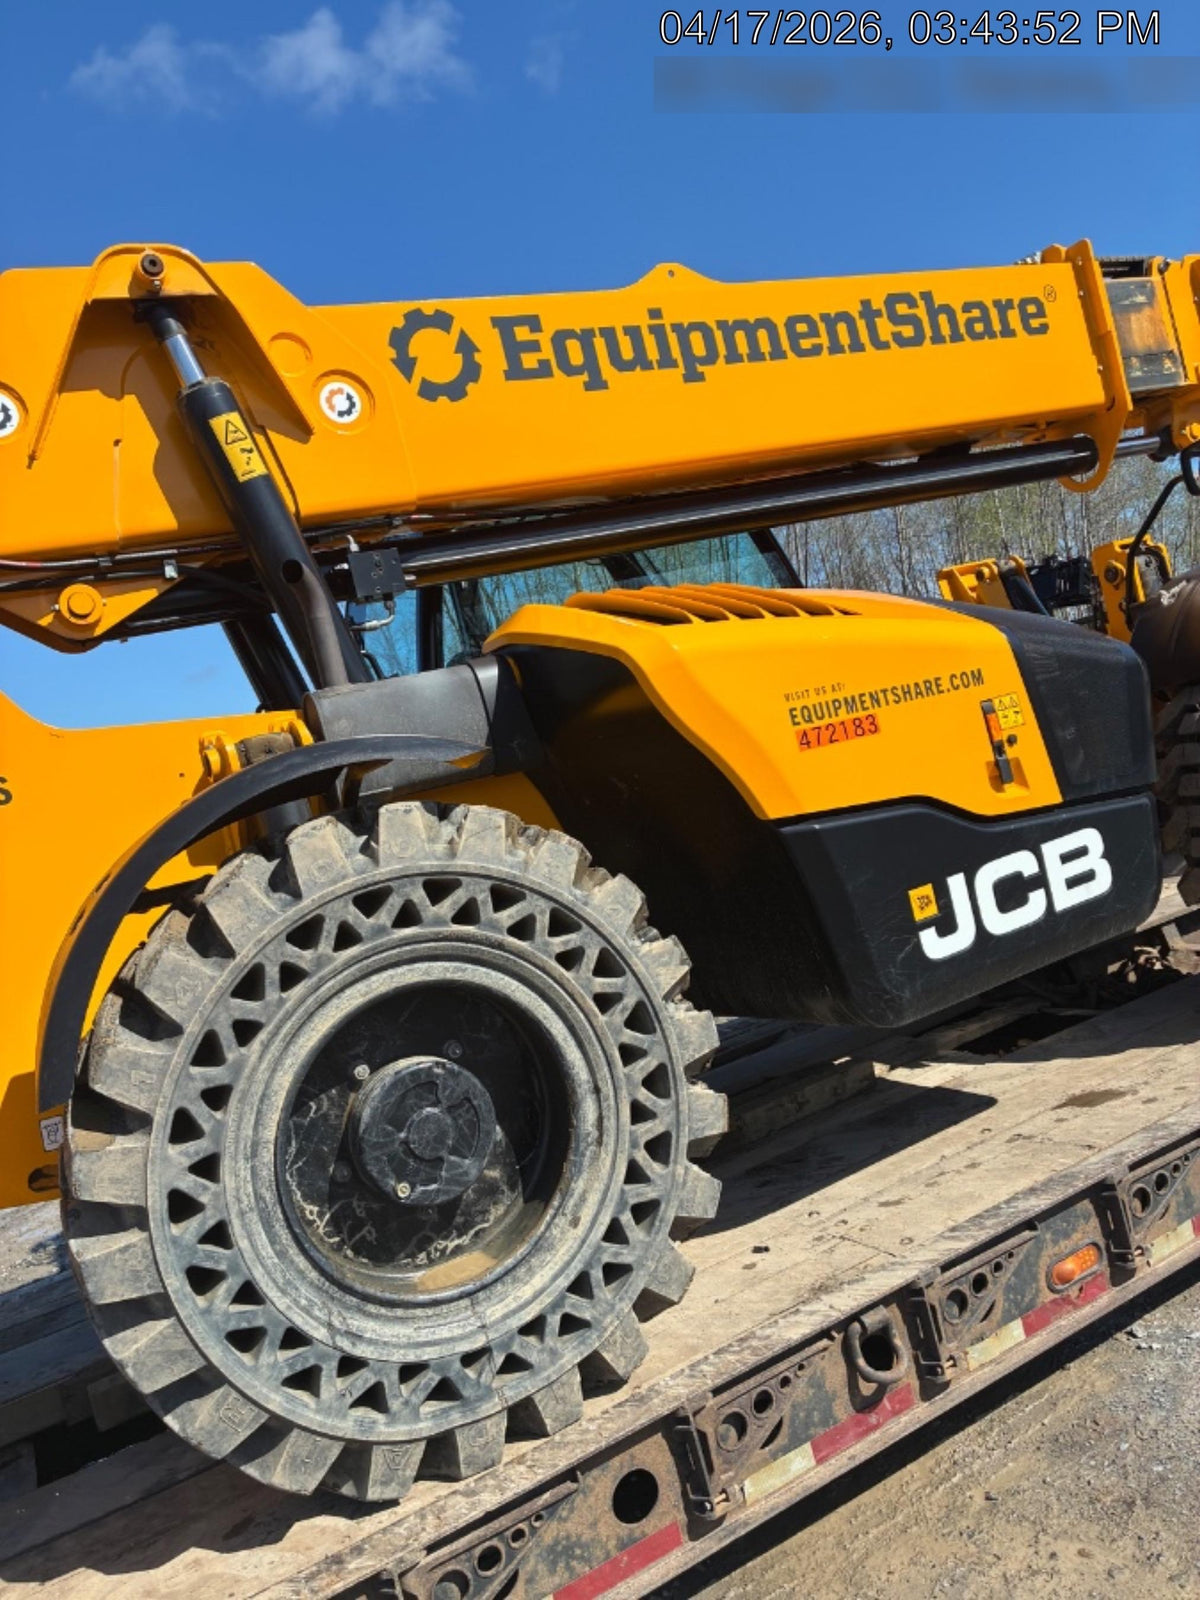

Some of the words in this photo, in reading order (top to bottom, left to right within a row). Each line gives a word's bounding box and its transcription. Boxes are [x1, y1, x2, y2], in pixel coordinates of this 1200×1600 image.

[783, 689, 810, 702] VISIT
[813, 685, 828, 696] US
[788, 668, 985, 727] EQUIPMENTSHARE.COM
[799, 714, 878, 749] 472183
[917, 827, 1113, 961] JCB
